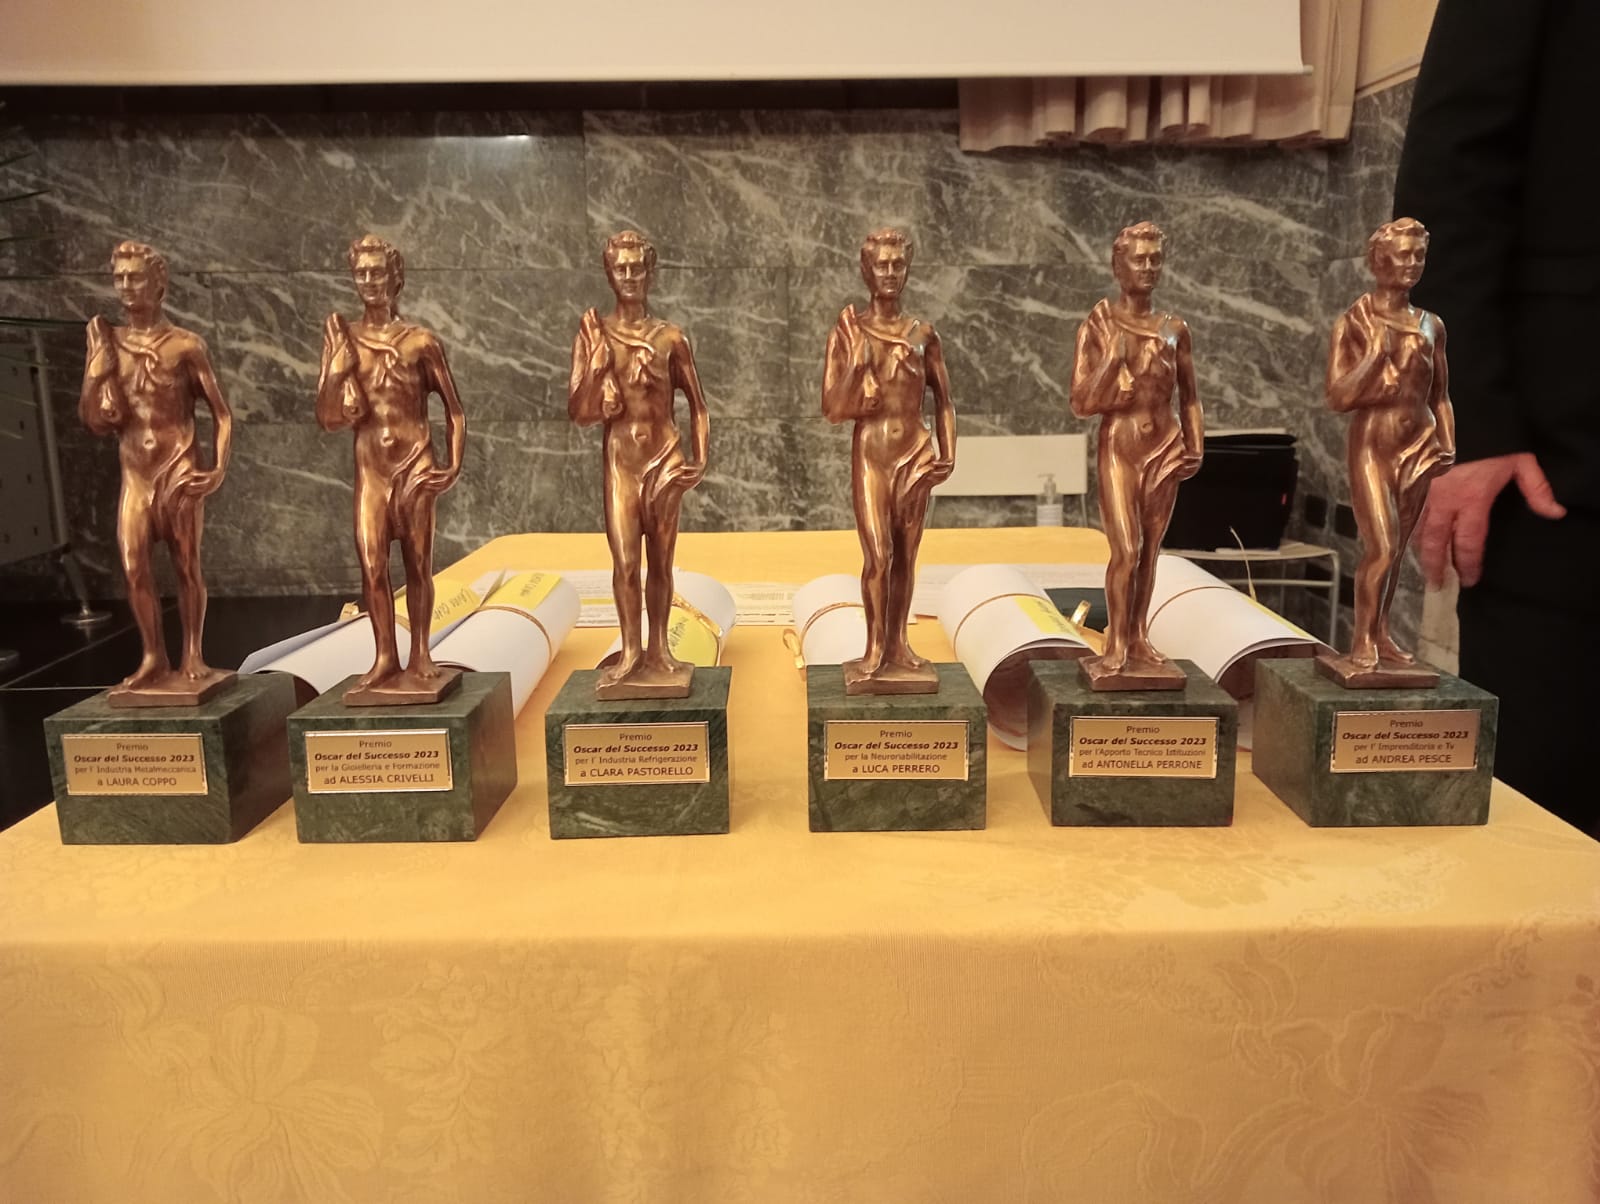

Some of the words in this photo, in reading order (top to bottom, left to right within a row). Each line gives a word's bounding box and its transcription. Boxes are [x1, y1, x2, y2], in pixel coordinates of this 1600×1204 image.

[1390, 720, 1424, 728] Premio
[619, 733, 652, 741] Premio
[880, 730, 912, 738] Premio
[1343, 732, 1371, 740] Oscar
[1442, 731, 1469, 739] 2023
[359, 740, 392, 748] Premio
[1079, 737, 1108, 745] Oscar
[1111, 737, 1127, 745] del
[116, 743, 149, 751] Premio
[1354, 744, 1367, 752] per
[314, 753, 343, 761] Oscar
[639, 756, 697, 764] Refrigerazione
[1355, 755, 1368, 764] ad
[1371, 755, 1415, 764] ANDREA
[1418, 754, 1452, 763] PESCE
[1082, 761, 1093, 769] ad
[1097, 760, 1153, 769] ANTONELLA
[1157, 760, 1202, 769] PERRONE
[74, 767, 88, 775] per
[315, 765, 328, 773] per
[590, 769, 624, 777] CLARA
[627, 767, 694, 776] PASTORELLO
[862, 765, 889, 773] LUCA
[892, 765, 940, 773] PERRERO
[106, 778, 139, 786] LAURA
[142, 777, 177, 785] COPPO
[324, 776, 336, 784] ad
[340, 775, 383, 784] ALESSIA
[387, 774, 434, 783] CRIVELLI
